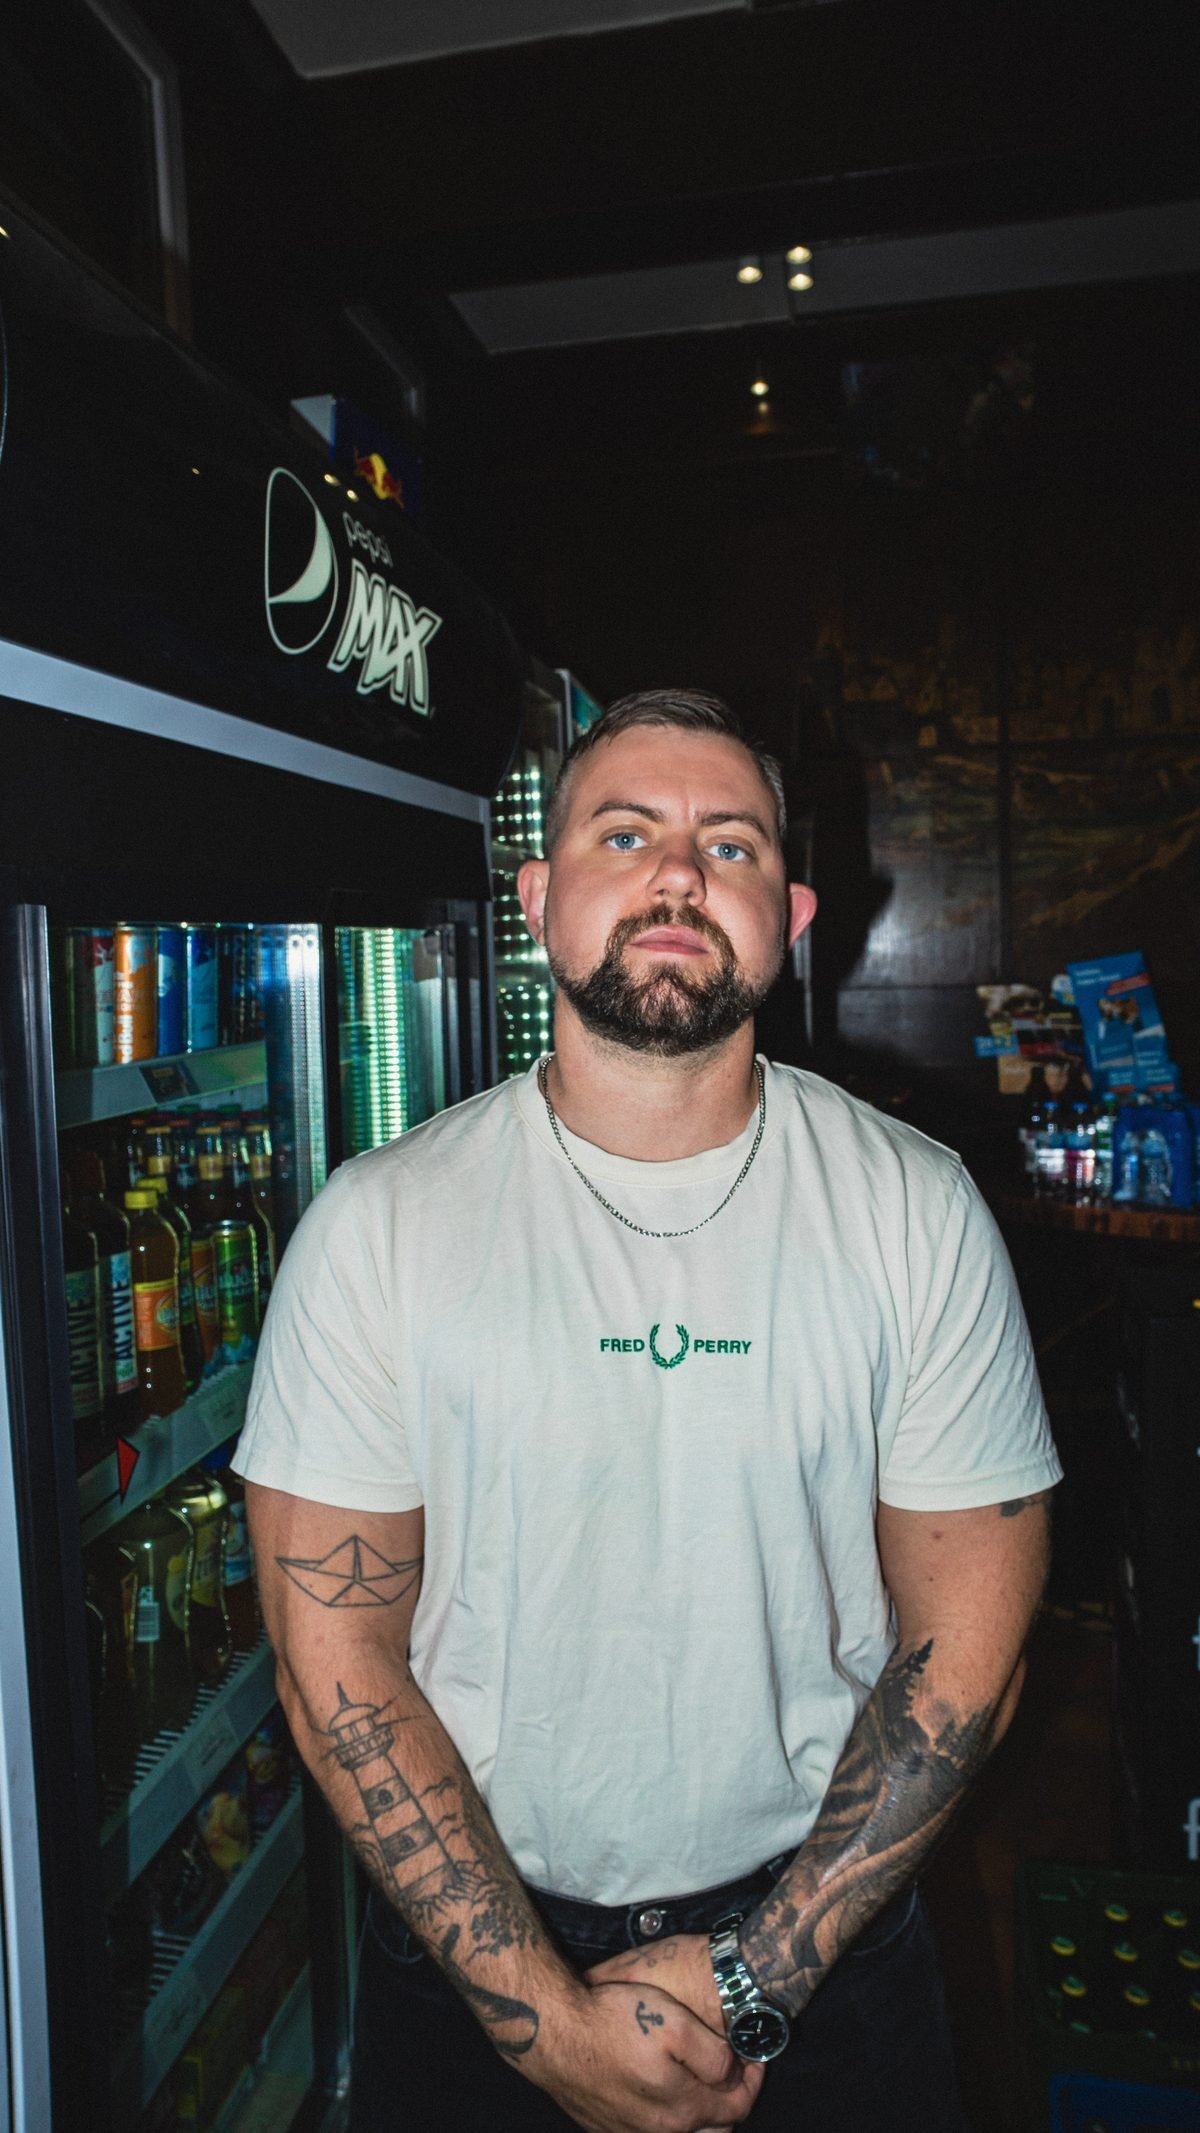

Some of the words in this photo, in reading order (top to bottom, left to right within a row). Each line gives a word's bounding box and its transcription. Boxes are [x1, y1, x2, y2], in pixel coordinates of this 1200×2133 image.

[342, 511, 394, 568] pepsi
[326, 557, 443, 718] MAX
[110, 1280, 134, 1360] ACTIVE
[600, 1338, 645, 1352] FRED
[693, 1339, 752, 1354] PERRY
